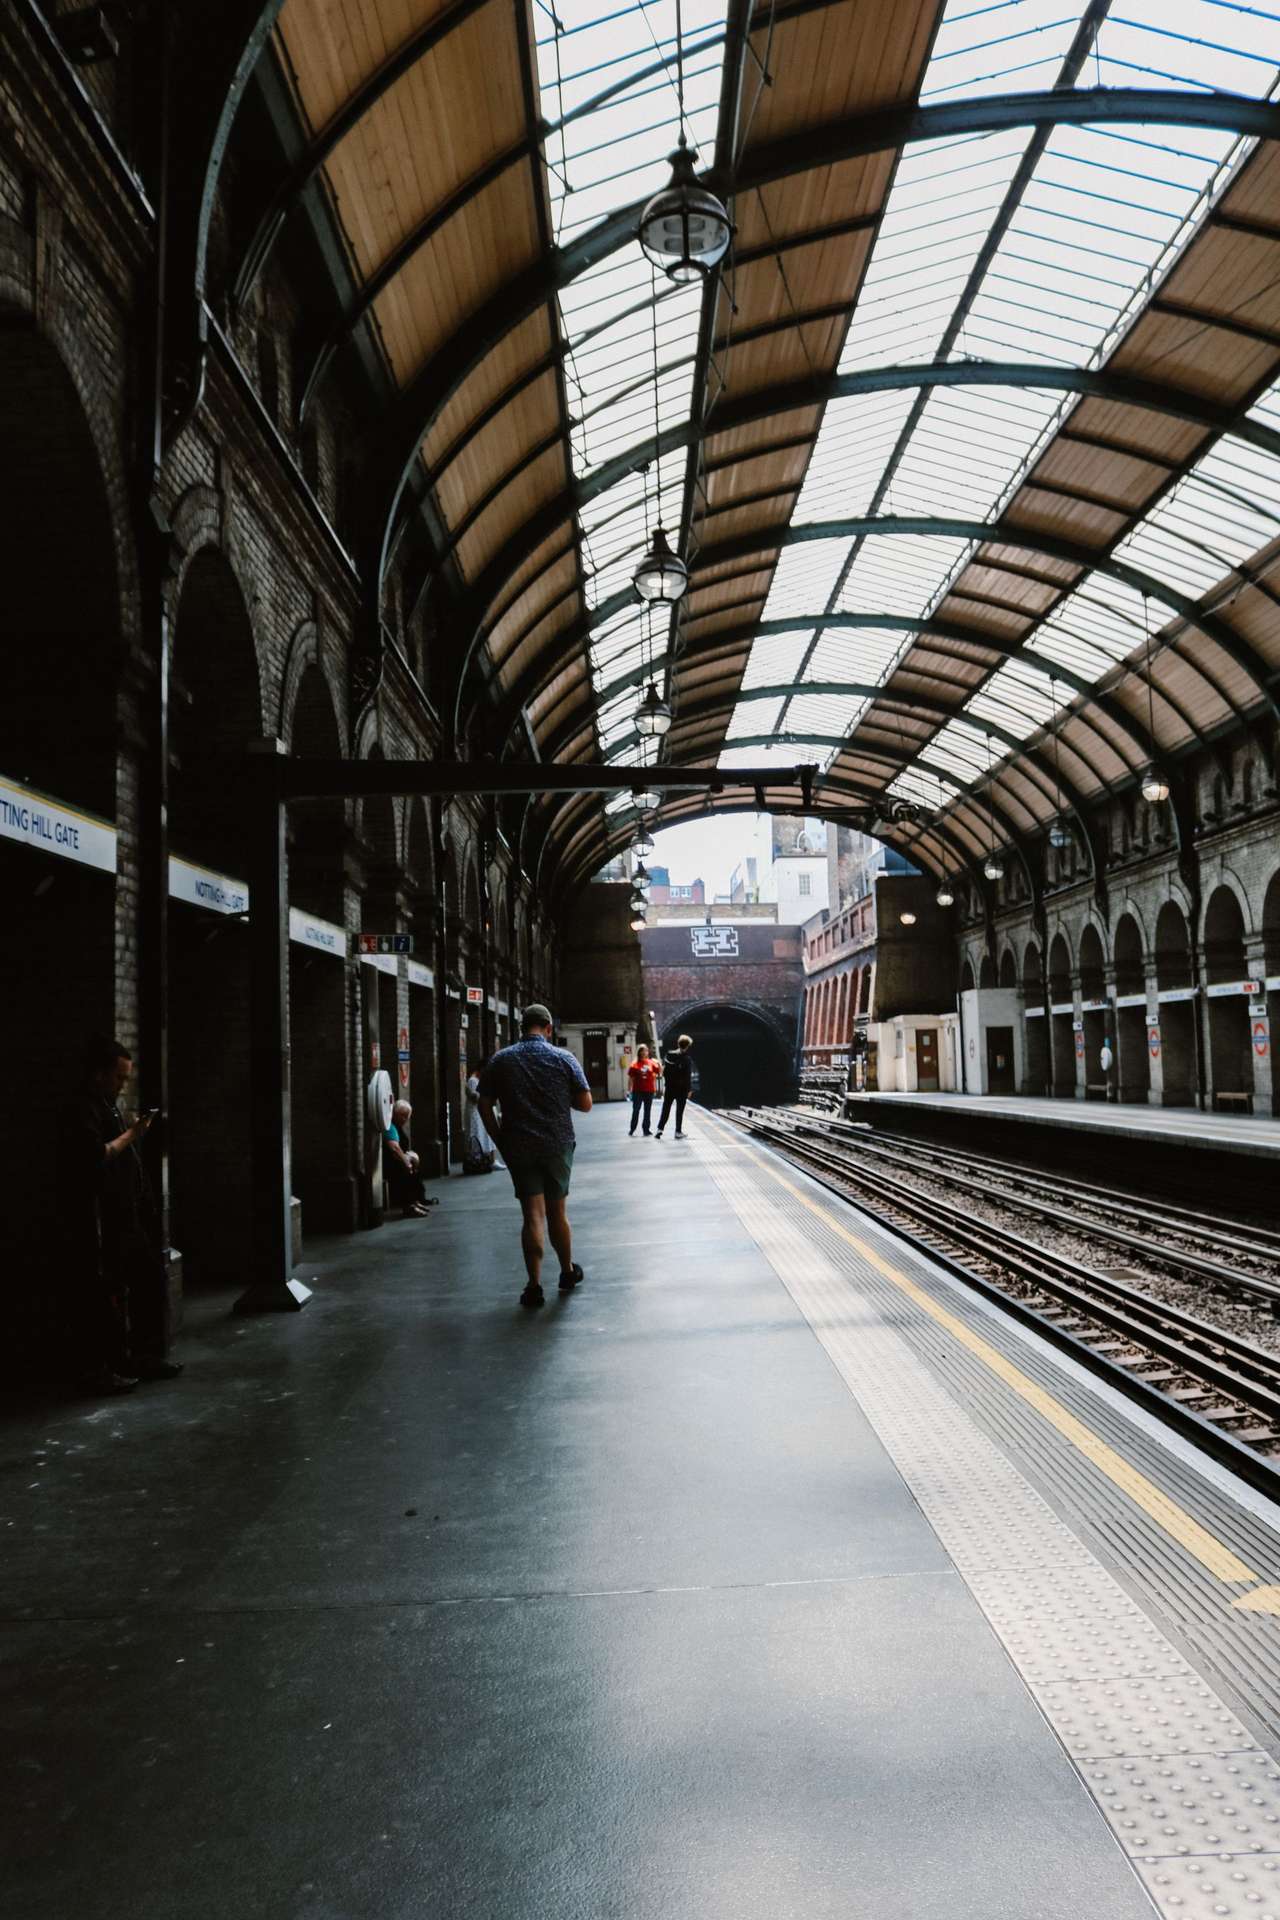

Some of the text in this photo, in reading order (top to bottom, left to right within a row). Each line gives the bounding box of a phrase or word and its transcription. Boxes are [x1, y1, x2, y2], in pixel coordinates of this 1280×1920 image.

[0, 799, 79, 850] TING HILL GATE
